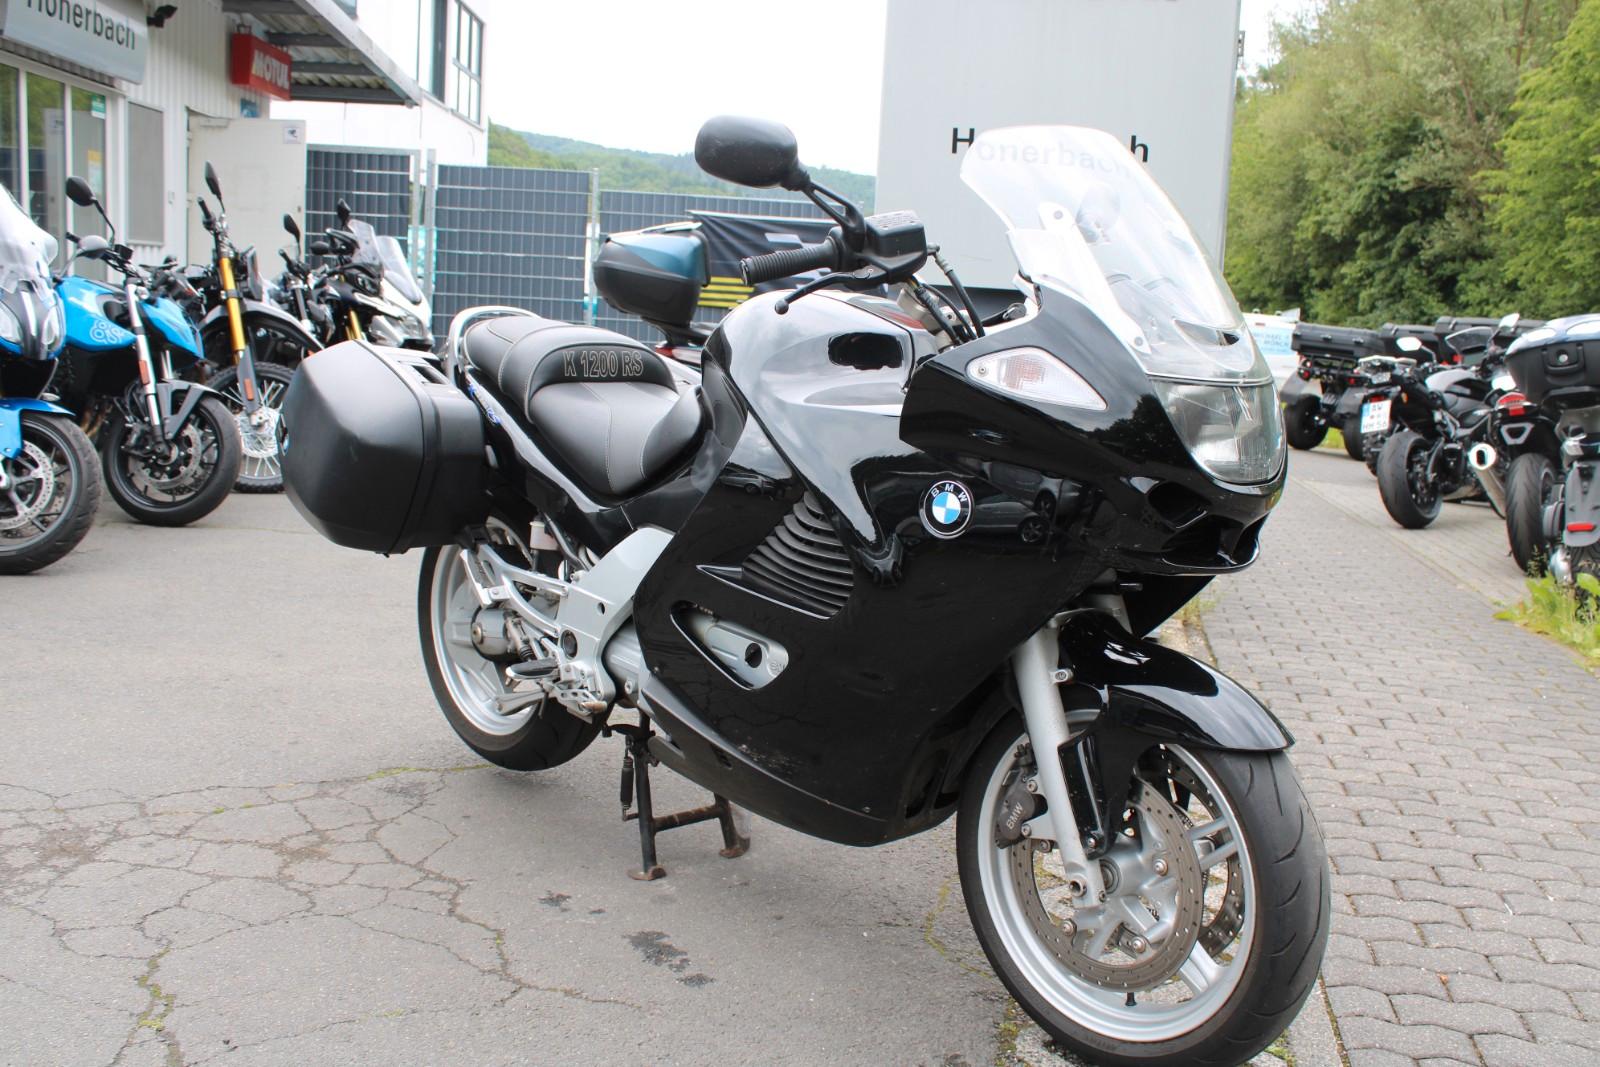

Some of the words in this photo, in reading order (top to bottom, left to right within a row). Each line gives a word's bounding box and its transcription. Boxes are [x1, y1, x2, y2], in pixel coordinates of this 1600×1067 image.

[251, 49, 289, 89] MOTUL
[563, 351, 577, 376] K
[580, 350, 618, 377] 1200
[622, 350, 644, 376] RS
[931, 483, 968, 503] BMW
[1006, 801, 1023, 830] BMW
